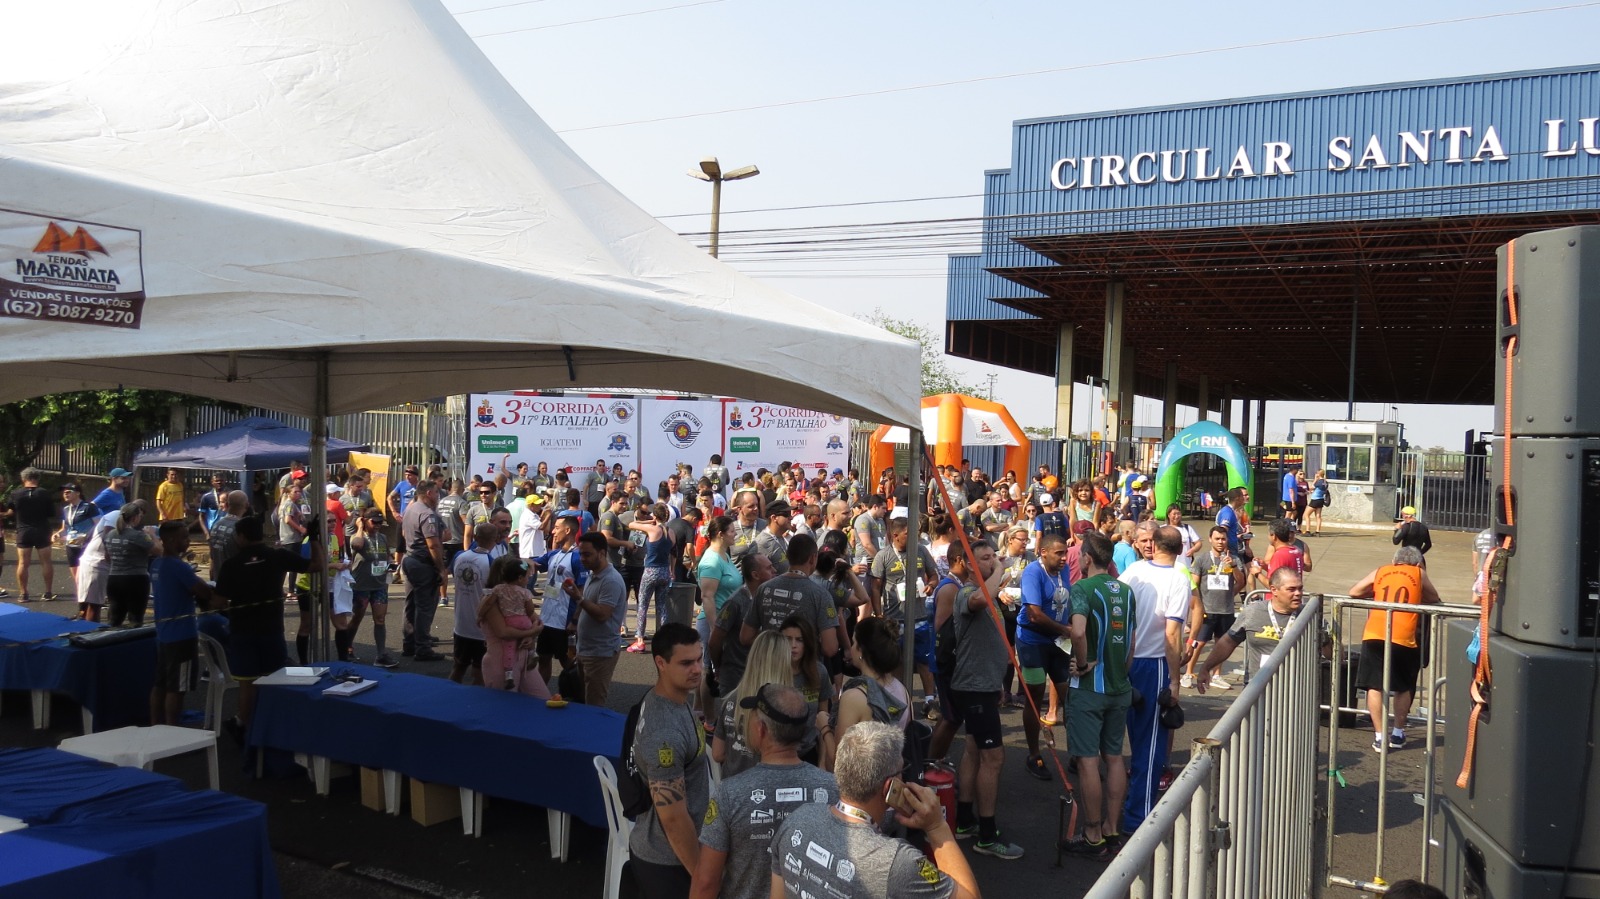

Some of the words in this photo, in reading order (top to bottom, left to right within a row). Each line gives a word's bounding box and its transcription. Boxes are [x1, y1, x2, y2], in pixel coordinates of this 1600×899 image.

[1051, 141, 1296, 190] CIRCULAR
[1328, 125, 1510, 172] SANTA
[1543, 117, 1600, 157] LU
[47, 255, 88, 266] TENDAS
[16, 258, 121, 285] MARANATA
[9, 288, 62, 301] VENDAS
[65, 292, 73, 303] E
[75, 295, 132, 308] LOCAÇÕES
[3, 298, 43, 317] (62)
[48, 303, 135, 324] 3087-9270
[531, 402, 605, 415] CORRIDA
[683, 412, 701, 427] MILITAR
[540, 438, 582, 447] IGUATEMI
[1201, 435, 1227, 447] RNI
[1382, 585, 1410, 604] 10
